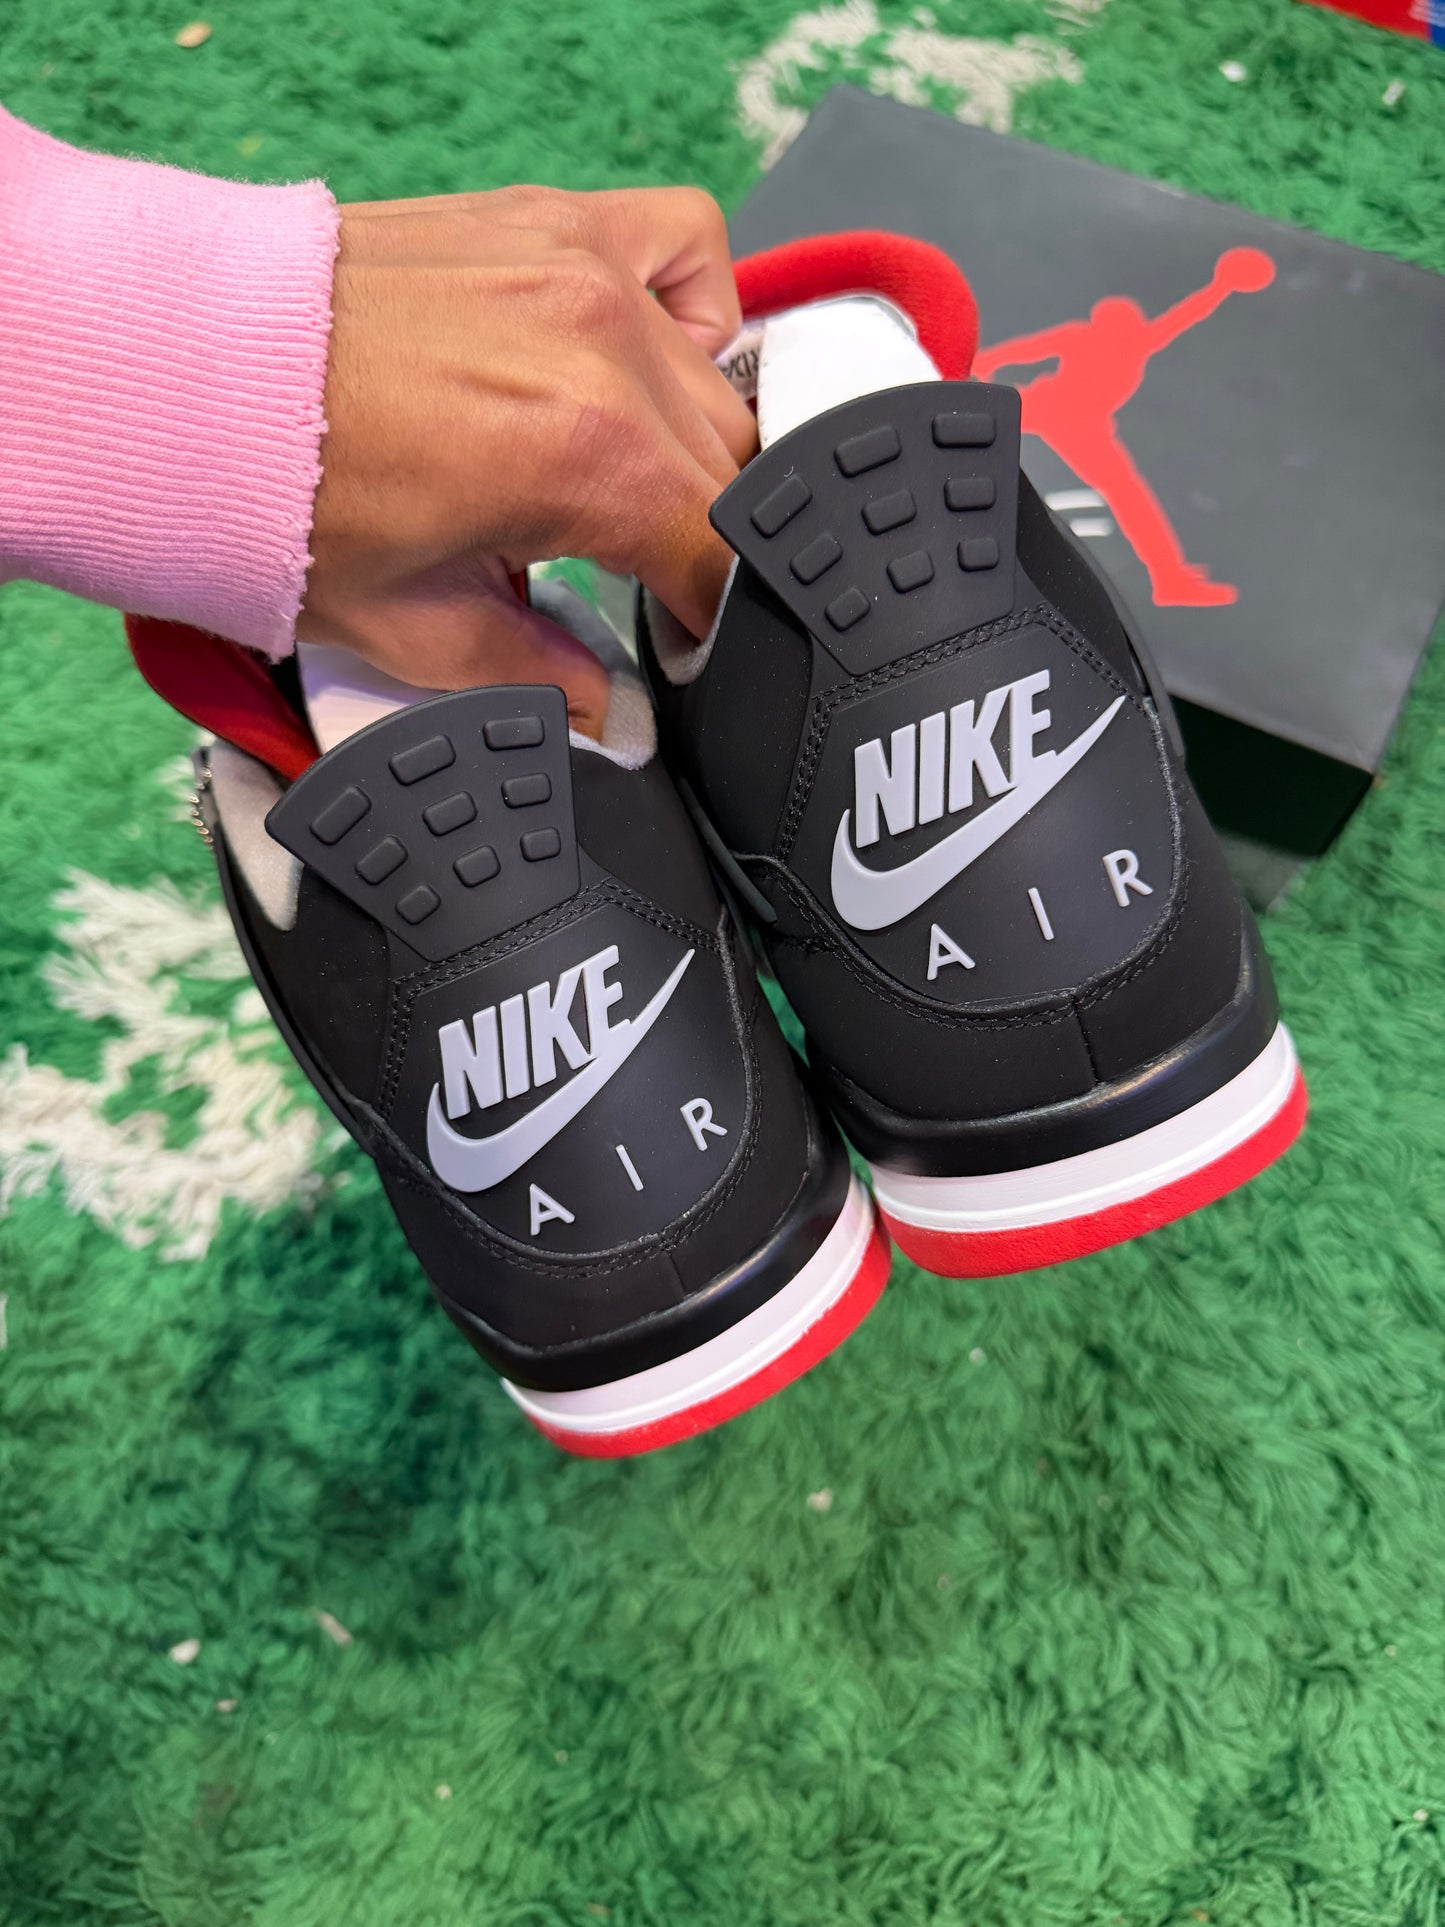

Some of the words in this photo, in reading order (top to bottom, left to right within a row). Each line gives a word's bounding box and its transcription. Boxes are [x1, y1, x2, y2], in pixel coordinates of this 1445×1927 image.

[855, 669, 1056, 848] NIKE
[927, 849, 1153, 980] AIR
[439, 945, 630, 1120] NIKE
[530, 1098, 727, 1236] AIR
